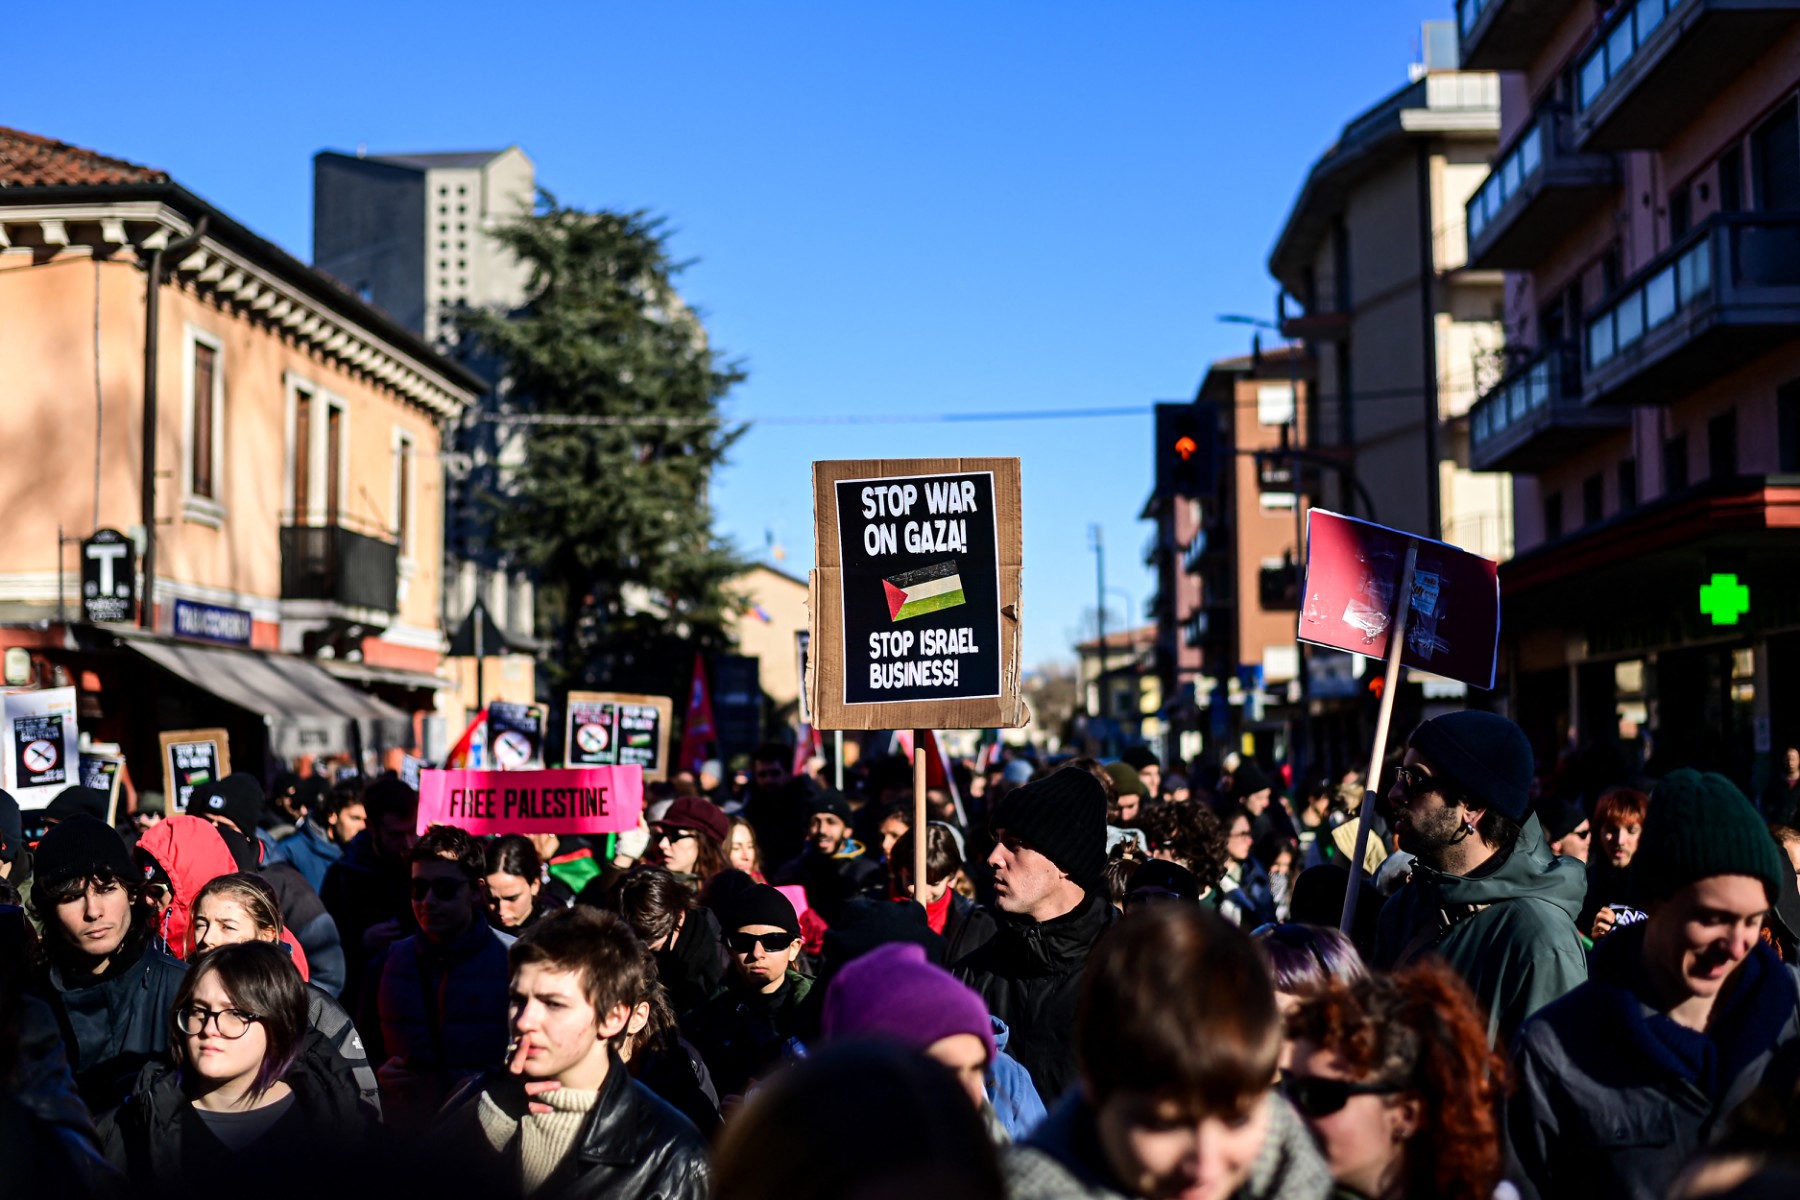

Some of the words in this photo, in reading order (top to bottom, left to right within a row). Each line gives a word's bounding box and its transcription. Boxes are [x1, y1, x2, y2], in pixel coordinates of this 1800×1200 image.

[861, 484, 918, 519] STOP
[924, 480, 978, 515] WAR
[864, 522, 897, 556] ON
[904, 518, 967, 554] GAZA!
[86, 543, 127, 596] T
[869, 630, 915, 660] STOP
[919, 627, 979, 656] ISRAEL
[869, 659, 959, 690] BUSINESS!
[449, 789, 496, 818] FREE
[504, 787, 610, 818] PALESTINE
